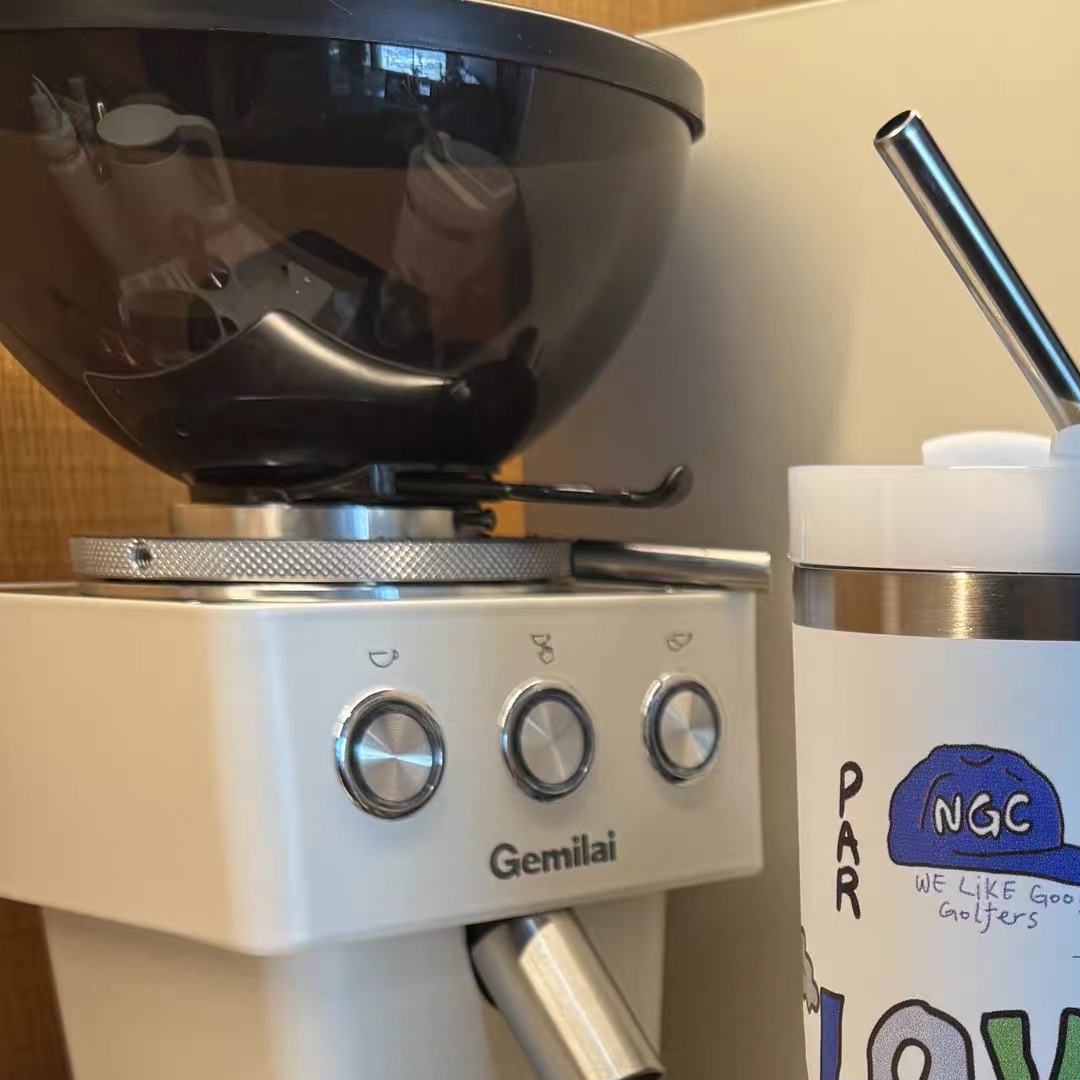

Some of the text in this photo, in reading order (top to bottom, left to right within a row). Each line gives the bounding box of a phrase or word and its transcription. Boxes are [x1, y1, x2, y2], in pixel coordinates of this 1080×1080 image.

[836, 760, 864, 920] PAR
[932, 792, 1031, 839] NGC
[489, 829, 617, 880] Gemilai
[916, 874, 947, 894] WE
